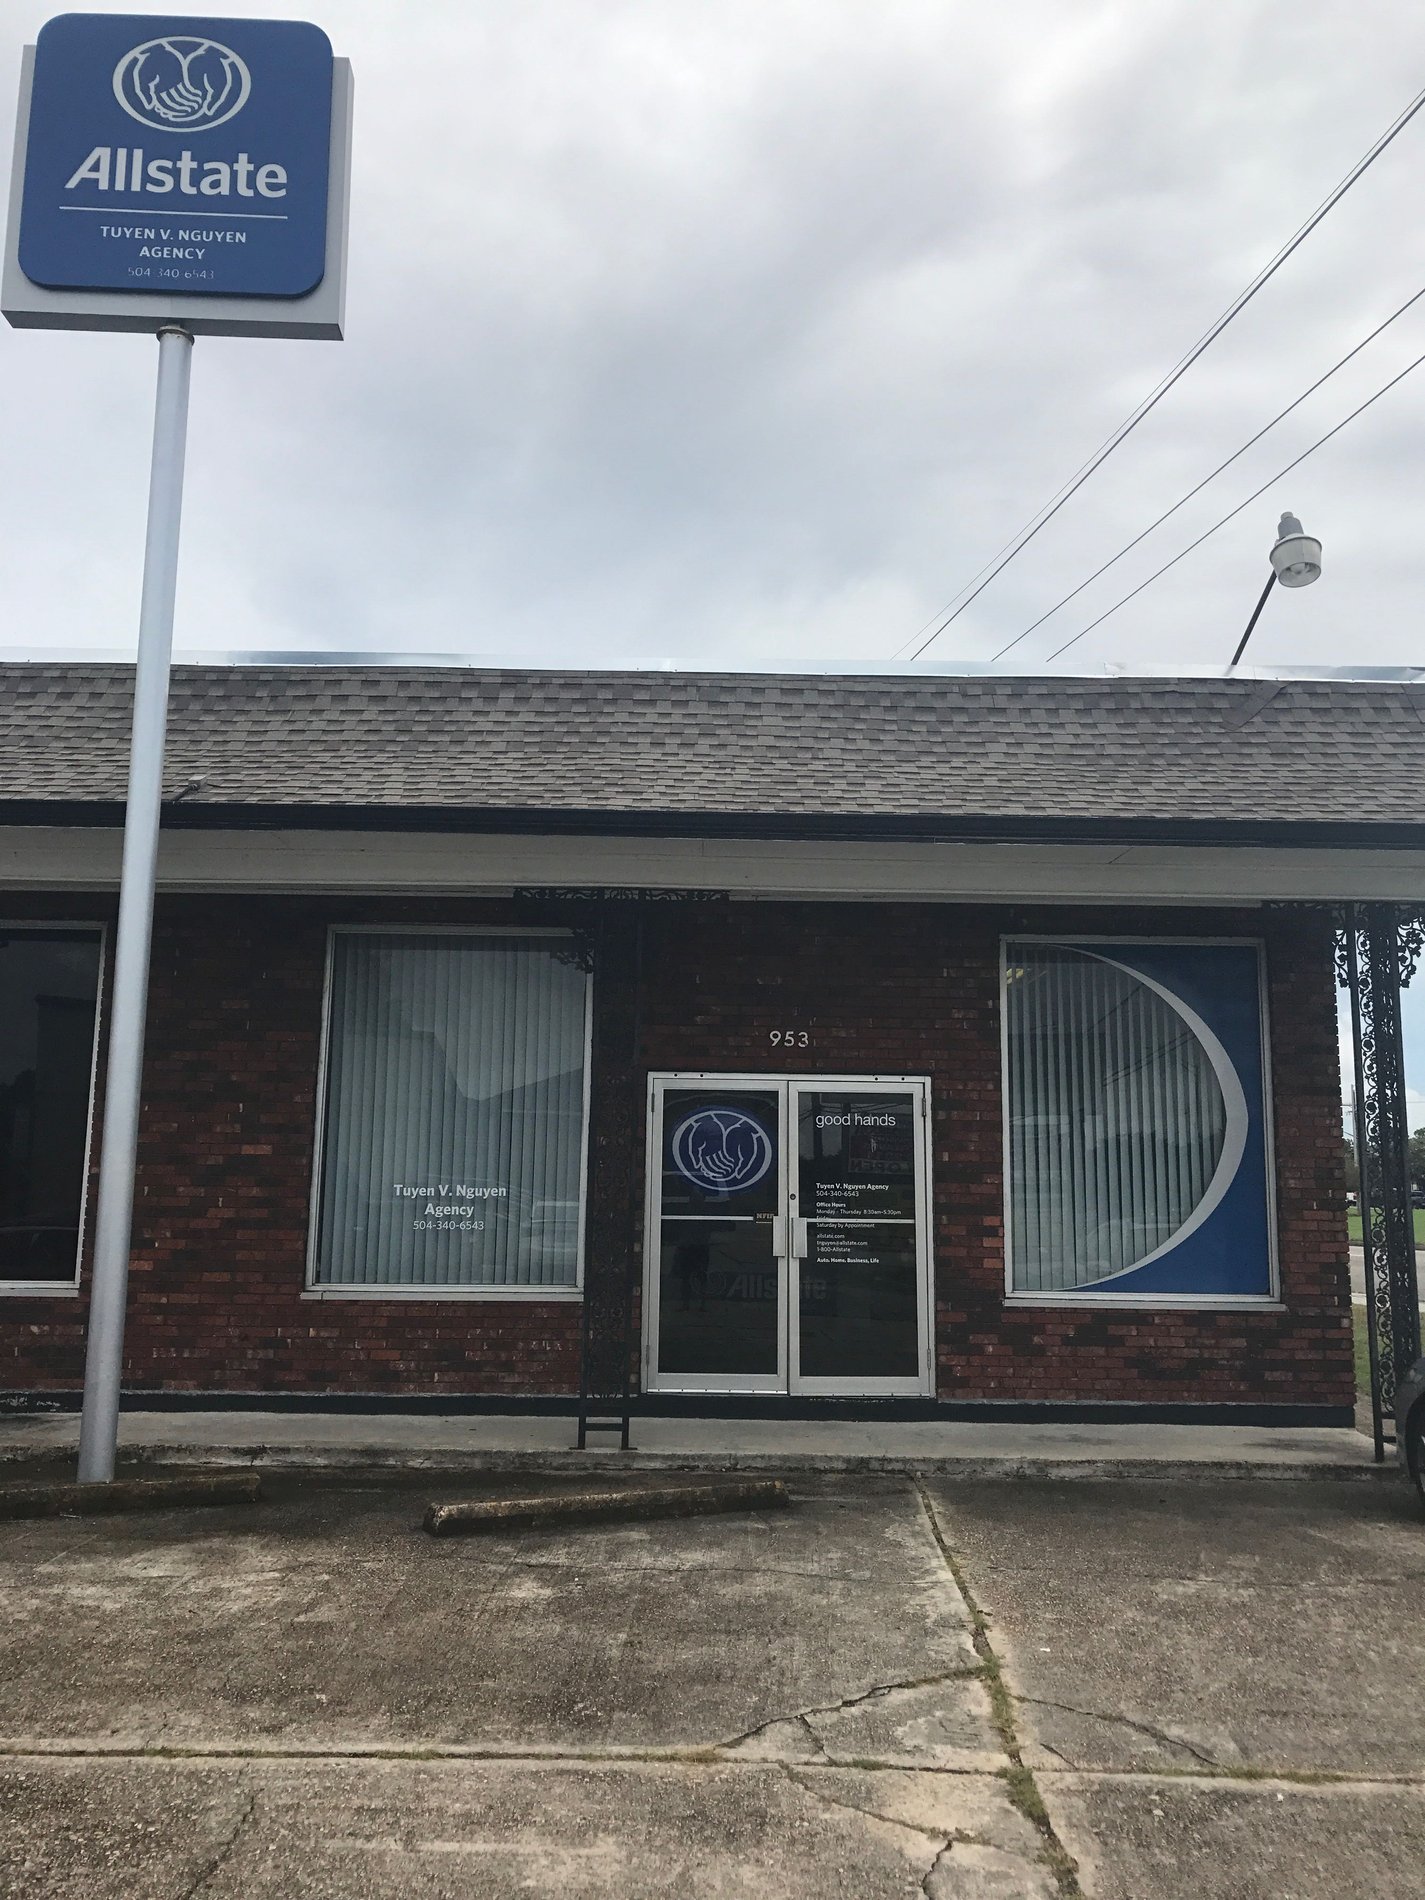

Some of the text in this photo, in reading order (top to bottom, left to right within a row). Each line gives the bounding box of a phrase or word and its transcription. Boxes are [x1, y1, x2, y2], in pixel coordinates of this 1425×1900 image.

[64, 146, 288, 199] Allstate
[101, 226, 247, 243] TUYEN V. NGUYEN
[139, 246, 206, 260] AGENCY
[769, 1030, 809, 1048] 953
[815, 1113, 896, 1128] good hands
[393, 1184, 507, 1199] Tuyen V. Nguyen
[815, 1182, 835, 1190] Tuyen
[843, 1183, 866, 1191] Nguyen
[867, 1183, 890, 1192] Agency
[424, 1203, 475, 1218] Agency
[412, 1220, 485, 1231] 504-340-6543
